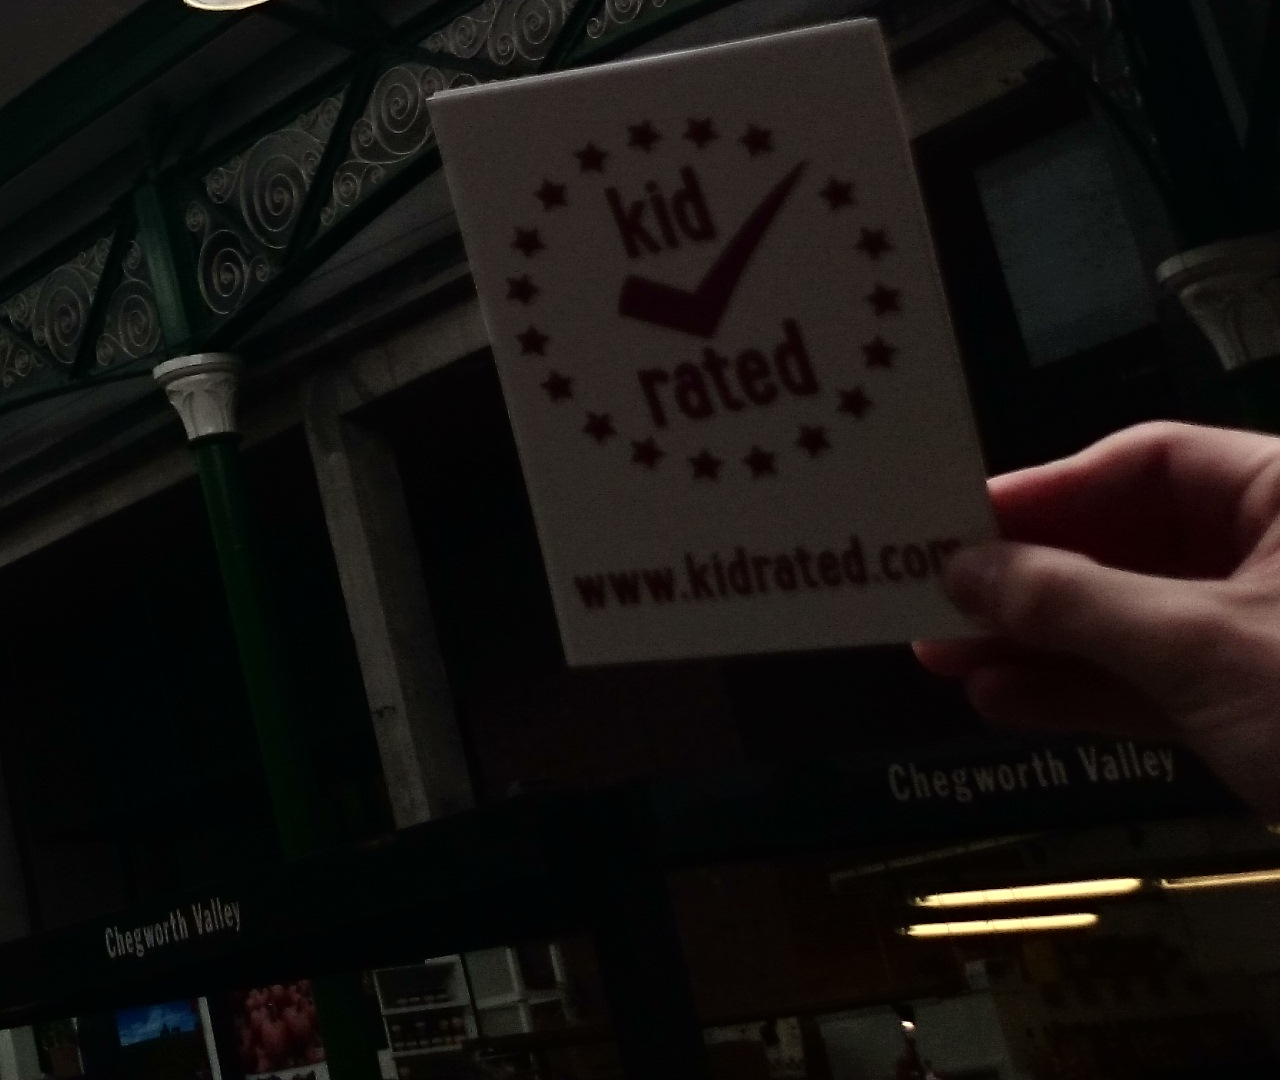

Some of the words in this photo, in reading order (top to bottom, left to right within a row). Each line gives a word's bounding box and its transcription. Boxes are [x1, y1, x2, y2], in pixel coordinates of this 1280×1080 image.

[605, 166, 717, 258] kid
[638, 319, 819, 428] rated
[887, 748, 1069, 803] Chegworth
[1076, 741, 1175, 784] Valley
[104, 907, 189, 959] Chegworth
[191, 896, 241, 936] Valley
